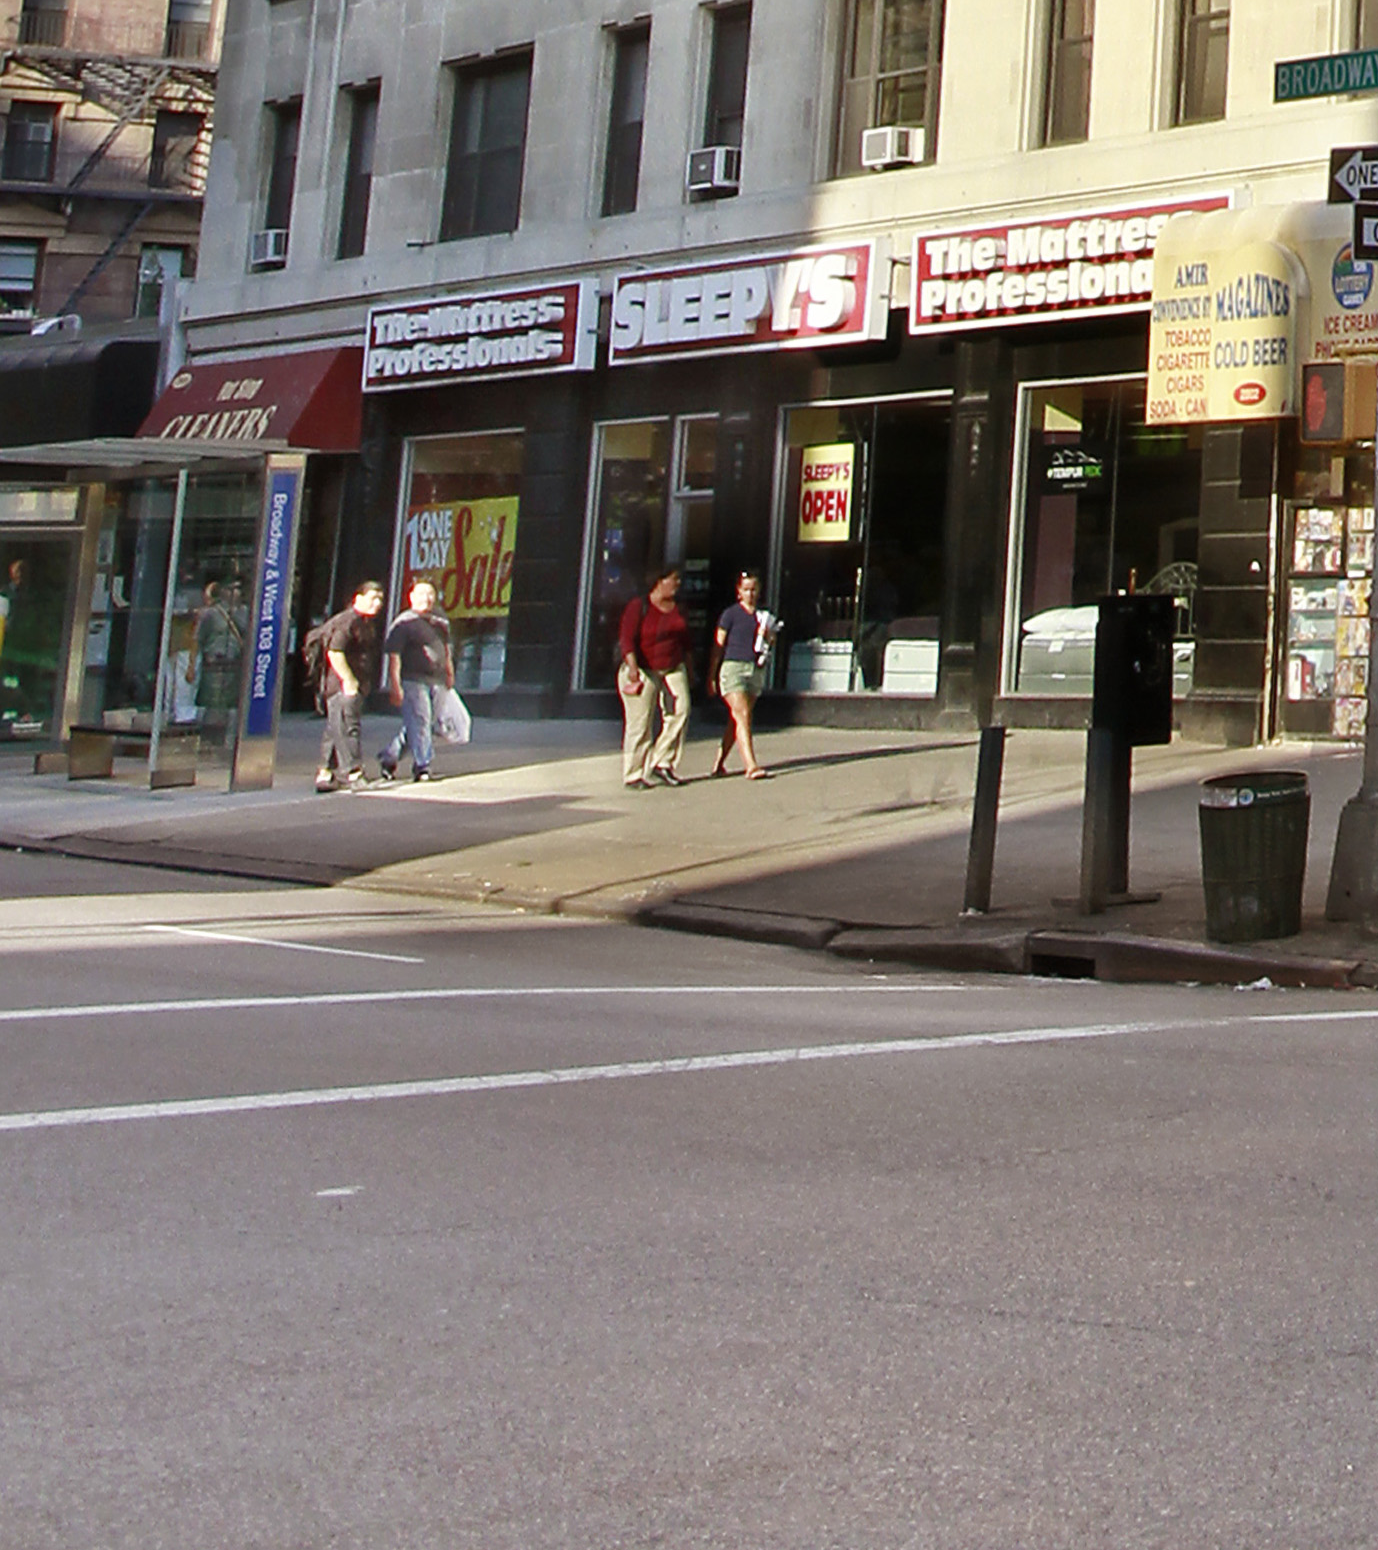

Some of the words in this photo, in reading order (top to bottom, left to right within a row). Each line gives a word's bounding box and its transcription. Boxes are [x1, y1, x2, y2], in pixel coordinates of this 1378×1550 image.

[1346, 163, 1378, 186] ONE
[925, 236, 996, 277] The
[1006, 213, 1169, 266] Mattres
[920, 259, 1153, 318] Professiona
[1174, 263, 1209, 289] AMIR
[613, 253, 858, 350] SLEEPY'S
[1216, 273, 1290, 322] MAGAZINES
[374, 311, 428, 345] The
[428, 296, 565, 336] Mattress
[1324, 316, 1340, 334] ICE
[1343, 312, 1378, 333] CREAM
[367, 329, 563, 378] Professionals
[1165, 328, 1212, 348] TOBACCO
[1214, 340, 1248, 369] COLD
[1253, 337, 1288, 366] BEER
[1156, 352, 1210, 372] CIGARETTE
[1166, 375, 1204, 394] CIGARS
[160, 405, 278, 439] CLEANERS
[1150, 400, 1176, 419] SODA
[802, 489, 848, 524] OPEN
[264, 493, 288, 568] Broadway
[420, 510, 453, 540] ONE
[420, 540, 451, 569] DAY
[441, 507, 514, 611] Sale
[264, 569, 280, 580] &
[260, 581, 281, 621] West
[258, 625, 275, 649] 108
[253, 654, 272, 698] Street
